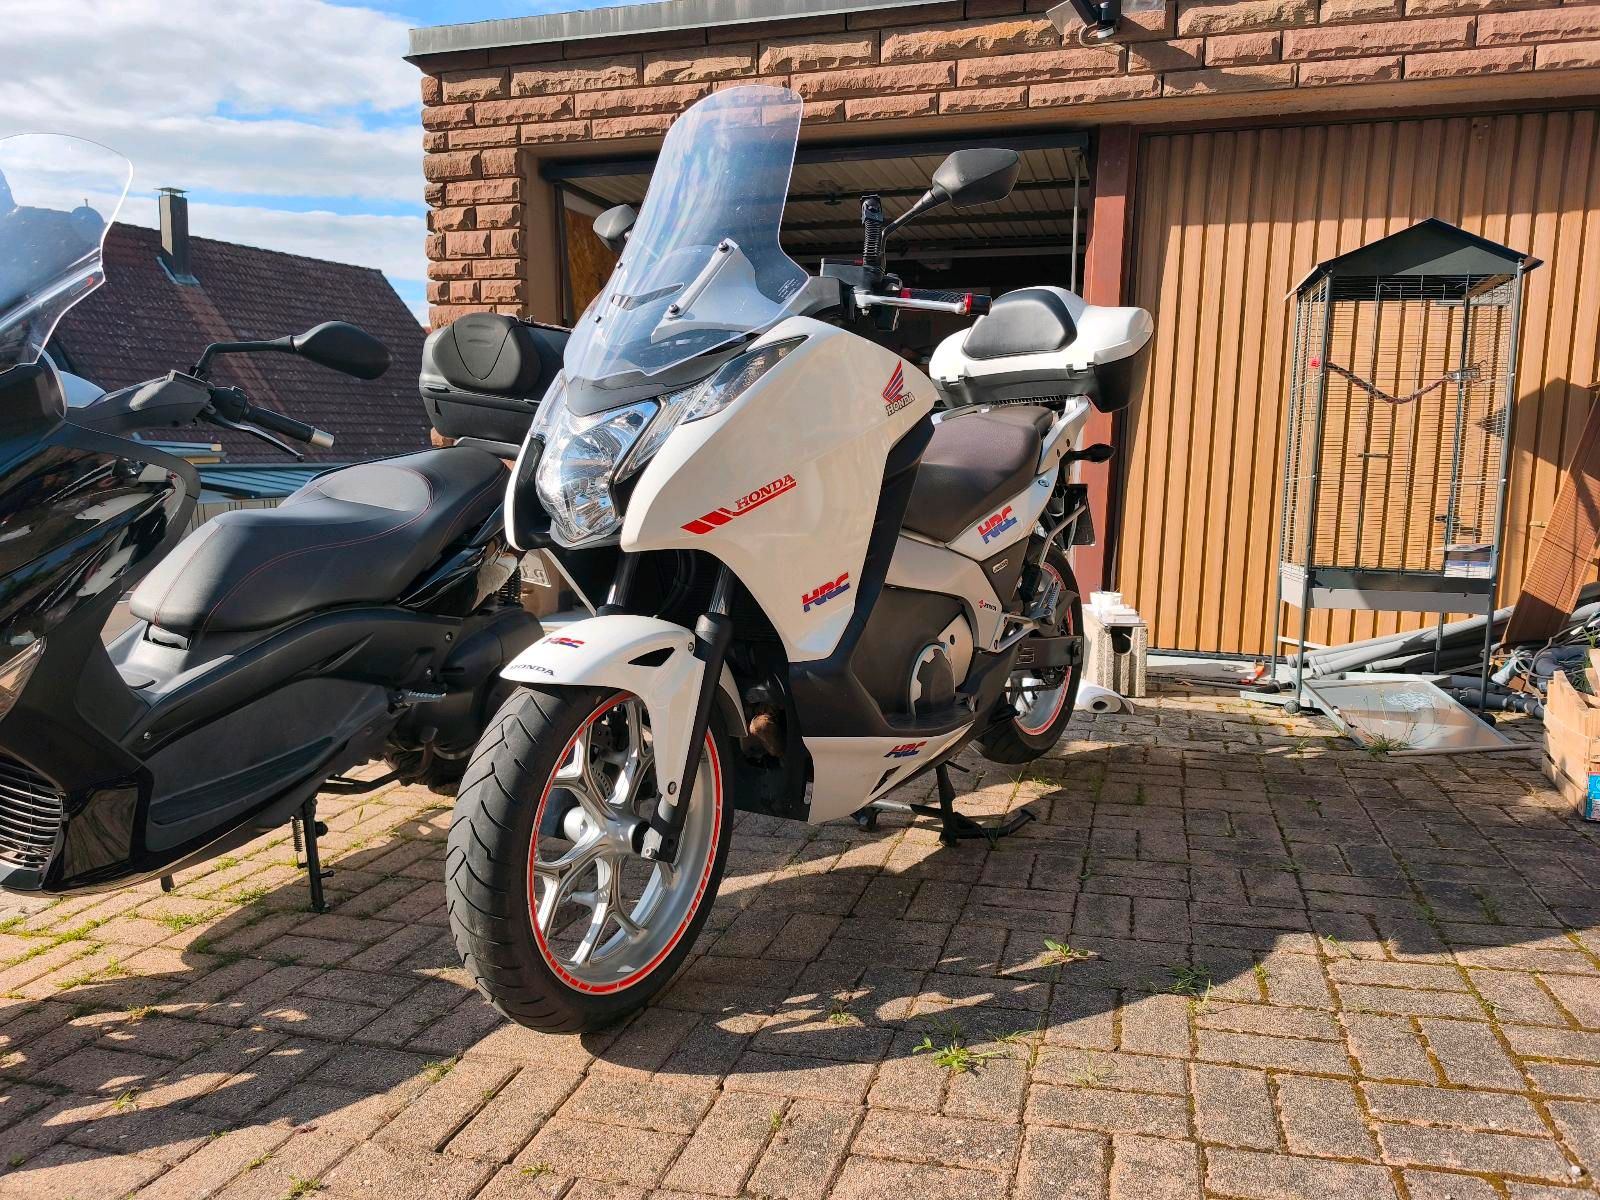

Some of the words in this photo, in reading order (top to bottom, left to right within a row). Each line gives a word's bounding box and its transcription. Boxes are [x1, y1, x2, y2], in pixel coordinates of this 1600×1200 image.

[885, 391, 916, 417] HONDA
[734, 474, 796, 511] HONDA
[977, 505, 1018, 545] HRC
[801, 571, 850, 613] HRC
[509, 664, 554, 677] HONDA
[883, 740, 928, 758] HRC
